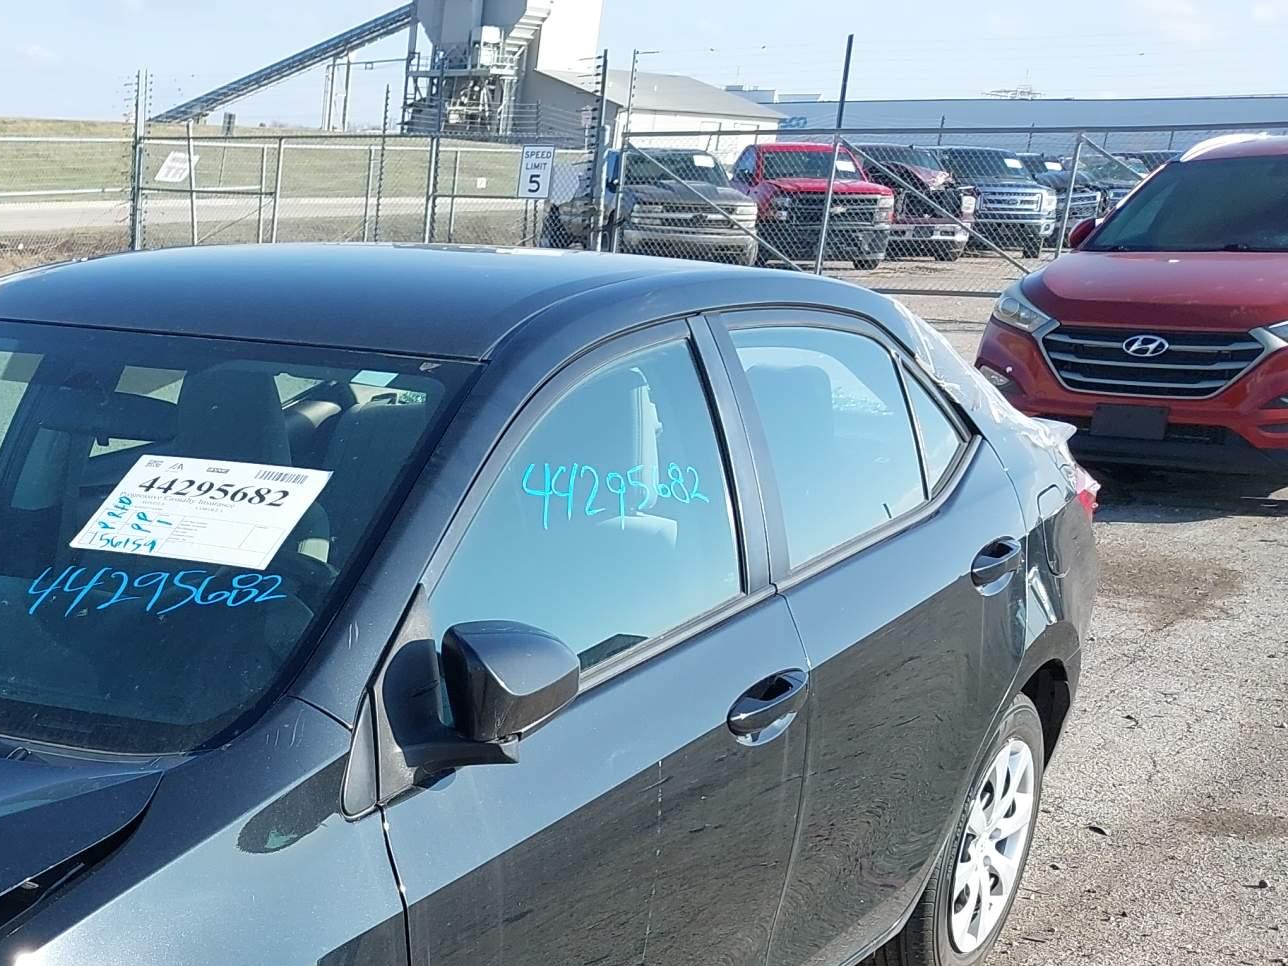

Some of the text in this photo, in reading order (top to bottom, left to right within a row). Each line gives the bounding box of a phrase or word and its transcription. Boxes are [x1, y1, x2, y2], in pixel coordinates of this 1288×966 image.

[525, 151, 552, 159] SPEED
[526, 162, 547, 170] LIMIT
[528, 174, 540, 193] 5
[139, 475, 290, 507] 44295682
[522, 463, 710, 530] 44295682
[29, 565, 287, 616] 44295682
